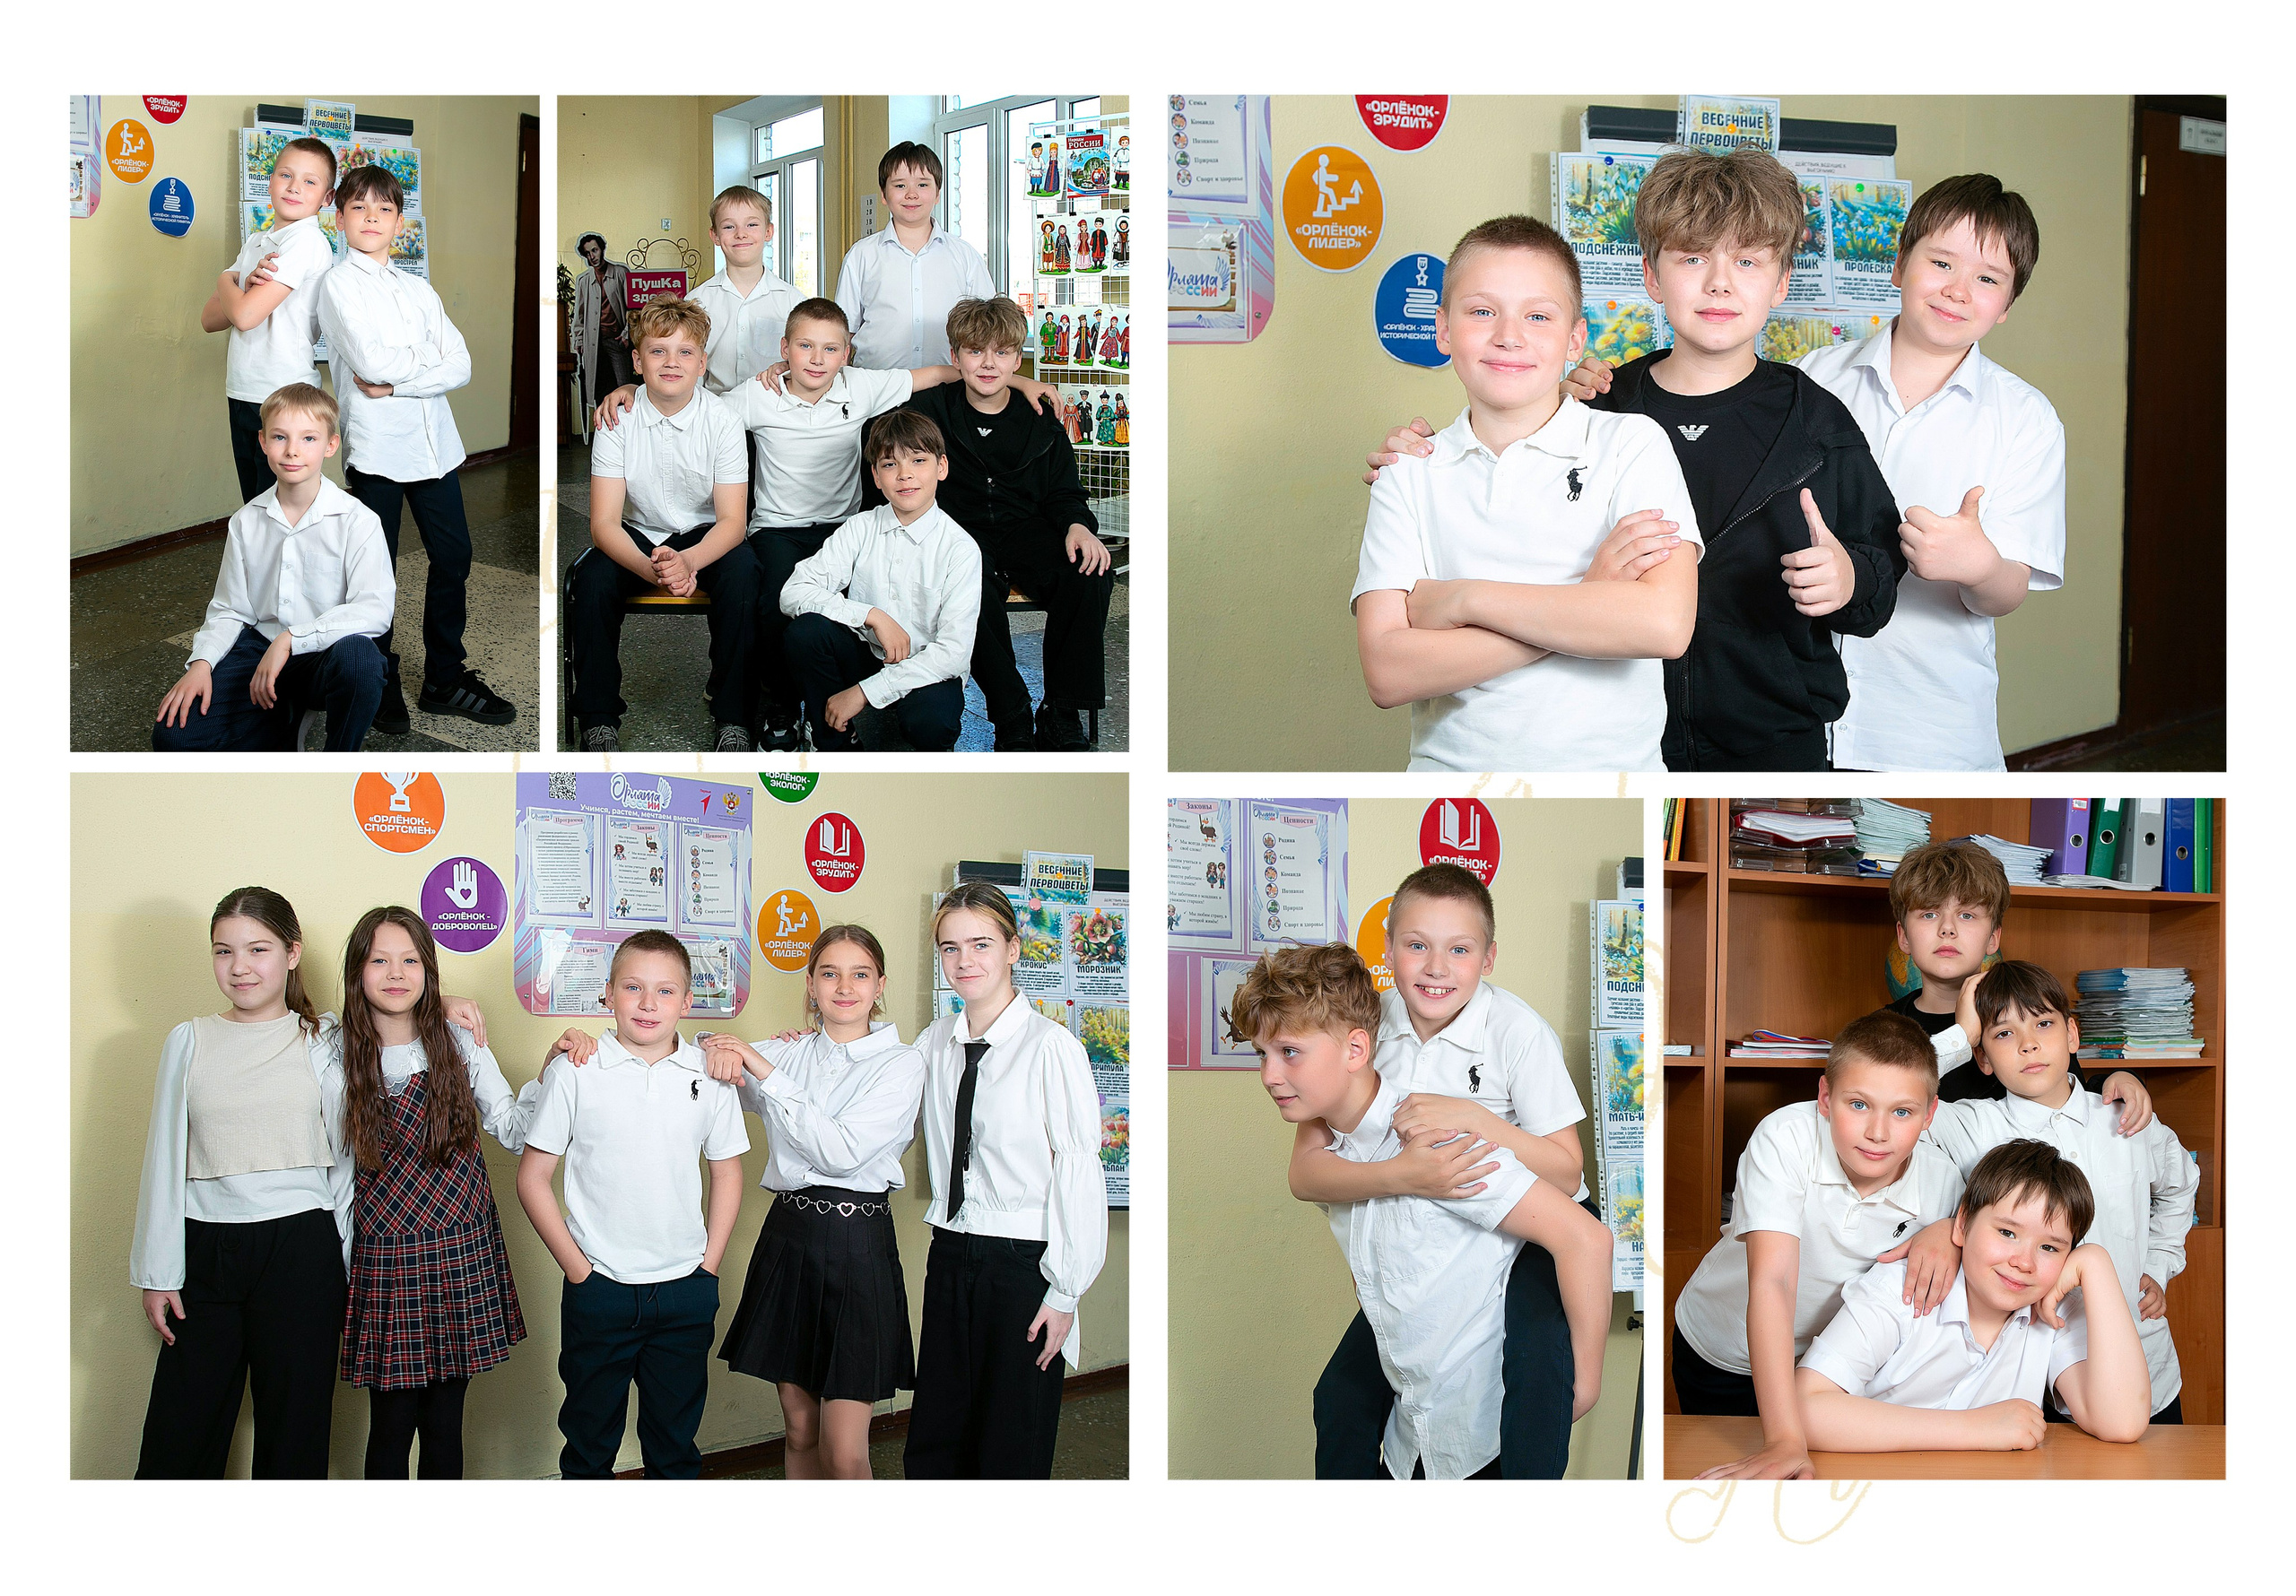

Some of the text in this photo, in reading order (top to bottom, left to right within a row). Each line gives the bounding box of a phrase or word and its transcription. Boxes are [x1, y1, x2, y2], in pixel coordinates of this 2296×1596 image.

[146, 96, 183, 108] «ОРЛЁНОК-
[150, 103, 179, 114] ЭРУДИТ»
[315, 108, 347, 119] ВЕСЕННИЕ
[1365, 100, 1440, 117] «ОРЛЁНОК-
[309, 119, 352, 131] ПЕРВОЦВЕТЫ
[1373, 113, 1433, 129] ЭРУДИТ»
[1701, 111, 1764, 129] ВЕСЕННИЕ
[1068, 140, 1101, 149] РОССИИ
[1690, 132, 1773, 151] ПЕРВОЦВЕТЫ
[117, 165, 144, 173] ЛИДЕР»
[1295, 222, 1373, 237] «ОРЛЁНОК-
[1308, 237, 1361, 249] ЛИДЕР»
[1570, 241, 1642, 256] ПОДСНЕЖНИ
[1844, 261, 1892, 273] ПРОЛЕСКА
[631, 277, 682, 292] ПушКа
[770, 779, 805, 791] ЭКОЛОГ»
[1185, 802, 1213, 810] Законы
[580, 803, 700, 823] Учимся, растем, мечтаем вместе!
[369, 814, 430, 826] «ОРЛЁНОК-
[1283, 816, 1314, 825] Ценности
[363, 823, 437, 835] СПОРТСМЕН»
[811, 859, 859, 871] «ОРЛЁНОК-
[1038, 864, 1083, 876] ВЕСЕННИЕ
[815, 868, 855, 879] ЭРУДИТ»
[1030, 878, 1089, 891] ПЕРВОЦВЕТЫ
[431, 922, 498, 932] ДОБРОВОЛЕЦ»
[771, 949, 806, 958] ЛИДЕР»
[1020, 960, 1048, 969] КРОКУС
[1077, 965, 1121, 974] МОРОЗНИК
[1091, 1063, 1124, 1072] ПРИМУЛА
